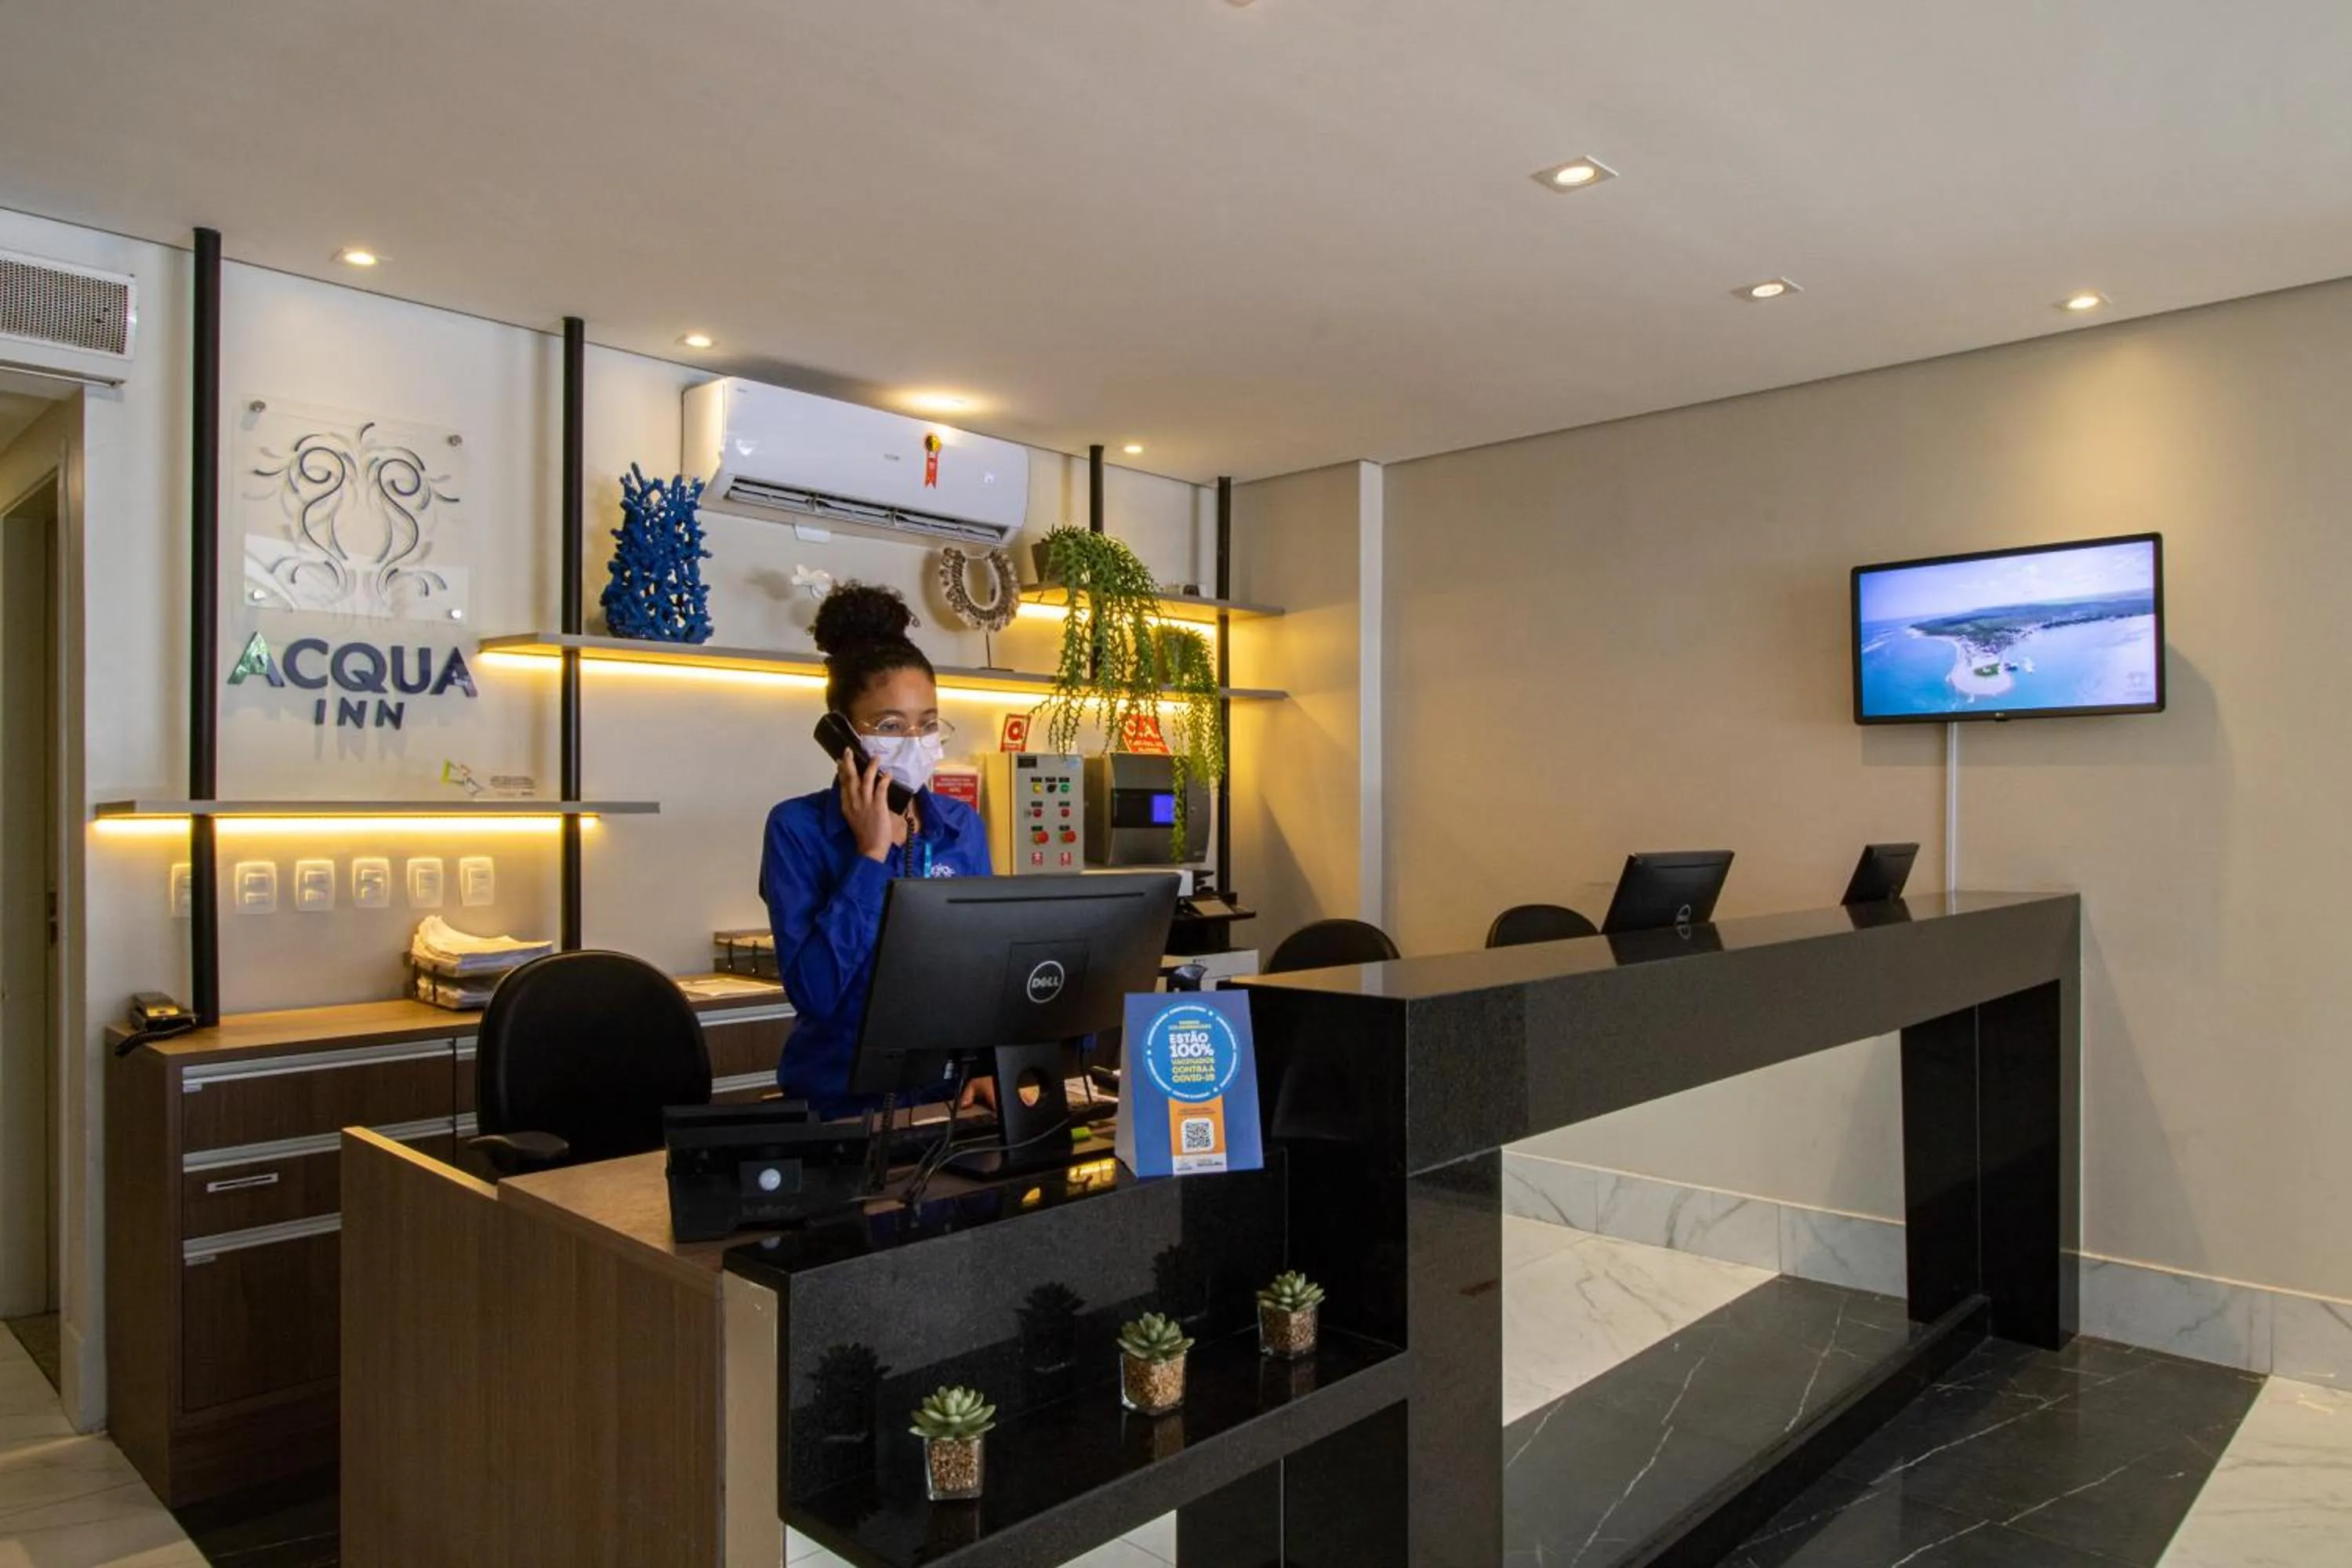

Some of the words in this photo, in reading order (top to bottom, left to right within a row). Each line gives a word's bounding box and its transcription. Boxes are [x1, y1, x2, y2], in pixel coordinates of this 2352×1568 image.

[227, 631, 477, 697] ACQUA
[314, 697, 405, 730] INN
[1032, 976, 1058, 988] DELL
[1169, 1030, 1208, 1044] ESTÃO
[1169, 1043, 1214, 1058] 100%
